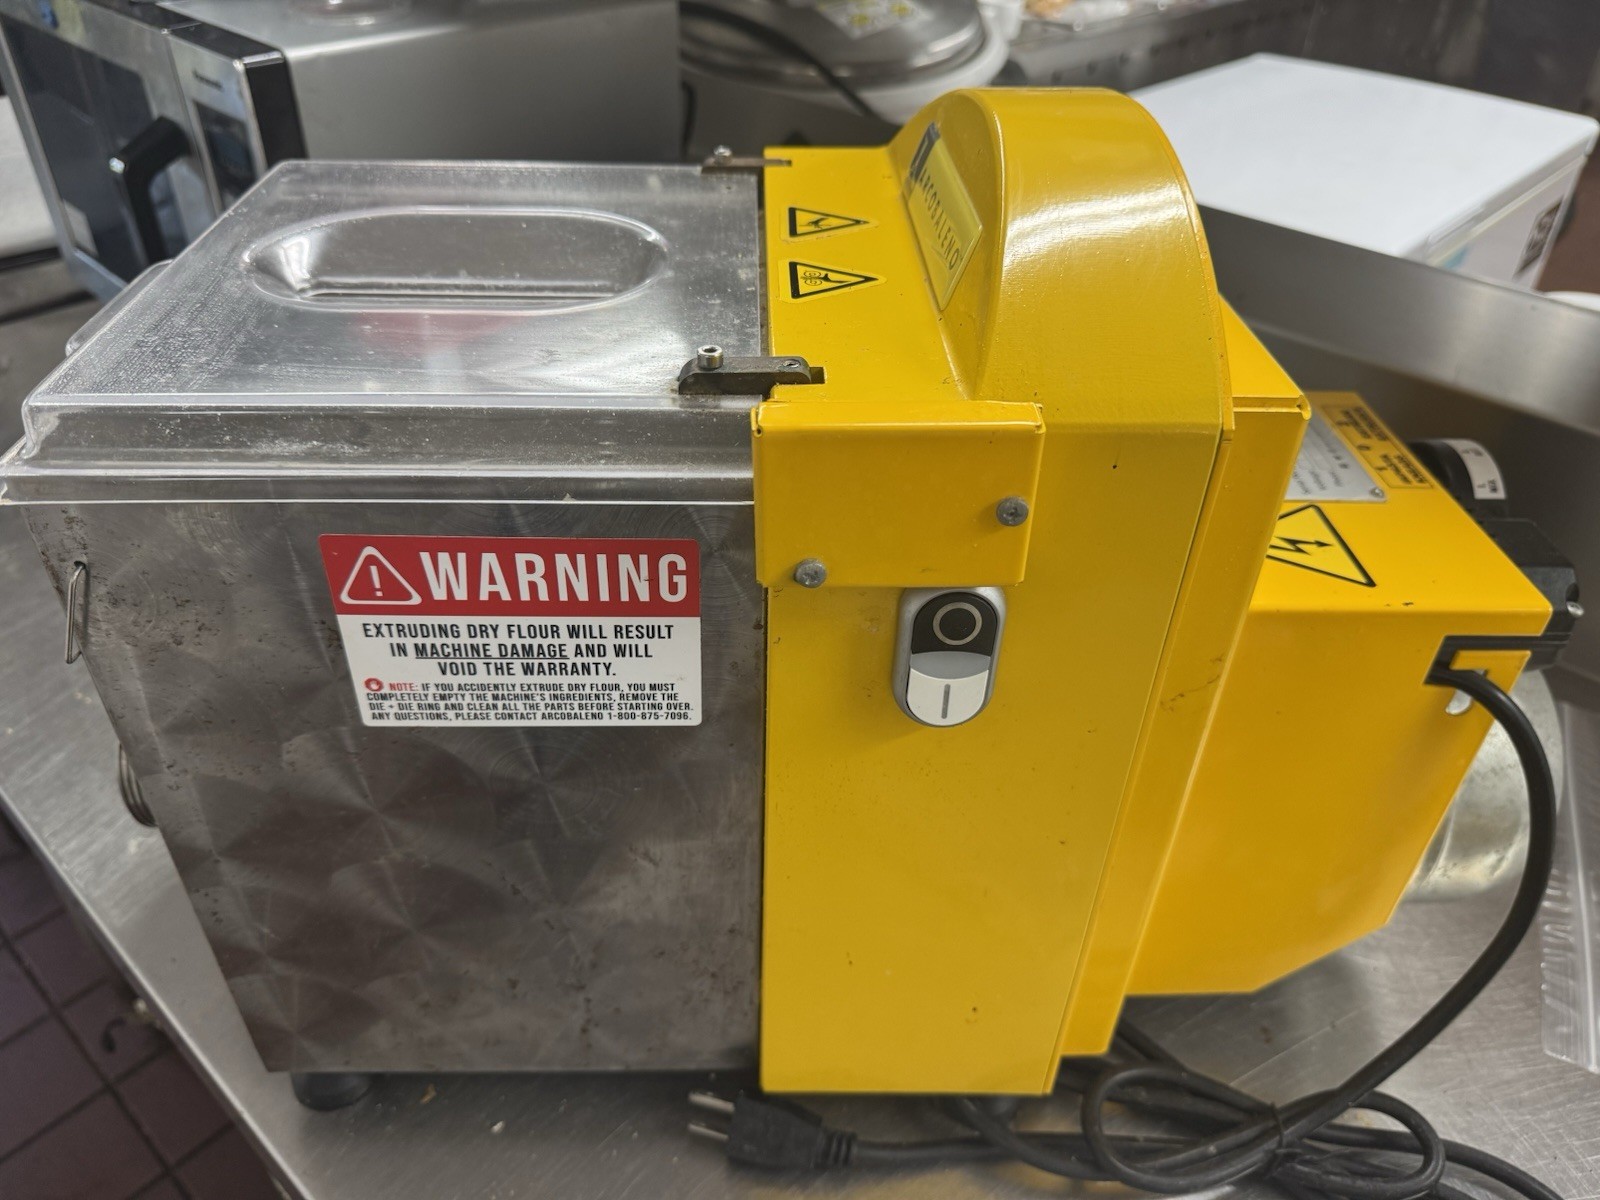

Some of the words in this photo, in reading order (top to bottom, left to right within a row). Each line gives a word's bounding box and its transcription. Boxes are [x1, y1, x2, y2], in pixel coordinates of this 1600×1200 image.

[918, 167, 960, 271] ARCOBALENO
[419, 551, 687, 602] WARNING
[362, 623, 460, 638] EXTRUDING
[467, 624, 499, 639] DRY
[507, 624, 560, 639] FLOUR
[567, 624, 607, 639] WILL
[614, 624, 673, 639] RESULT
[390, 643, 408, 657] IN
[414, 643, 492, 658] MACHINE
[498, 643, 567, 658] DAMAGE
[574, 644, 607, 658] AND
[614, 644, 653, 658] WILL
[438, 662, 477, 676] VOID
[483, 662, 516, 676] THE
[522, 662, 616, 676] WARRANTY.
[388, 683, 419, 692] NOTE:
[422, 683, 431, 692] IF
[435, 683, 454, 692] YOU
[458, 683, 516, 692] ACCIDENTLY
[520, 683, 564, 692] EXTRUDE
[568, 683, 587, 692] DRY
[590, 683, 624, 693] FLOUR,
[627, 683, 646, 692] YOU
[649, 683, 675, 692] MUST
[367, 692, 429, 701] COMPLETELY
[433, 692, 466, 701] EMPTY
[469, 692, 489, 701] THE
[492, 692, 546, 701] MACHINE'S
[549, 692, 616, 702] INGREDIENTS,
[620, 692, 657, 701] REMOVE
[661, 692, 679, 701] THE
[369, 702, 386, 711] DIE
[398, 702, 414, 711] DIE
[417, 702, 441, 711] RING
[444, 702, 464, 711] AND
[467, 702, 499, 711] CLEAN
[502, 702, 520, 711] ALL
[524, 702, 542, 711] THE
[545, 702, 575, 711] PARTS
[578, 702, 615, 711] BEFORE
[618, 702, 663, 711] STARTING
[666, 702, 694, 711] OVER.
[372, 712, 391, 721] ANY
[394, 712, 452, 722] QUESTIONS,
[456, 712, 492, 721] PLEASE
[495, 712, 537, 721] CONTACT
[542, 712, 604, 721] ARCOBALENO
[608, 712, 692, 721] 1-800-875-7096.
